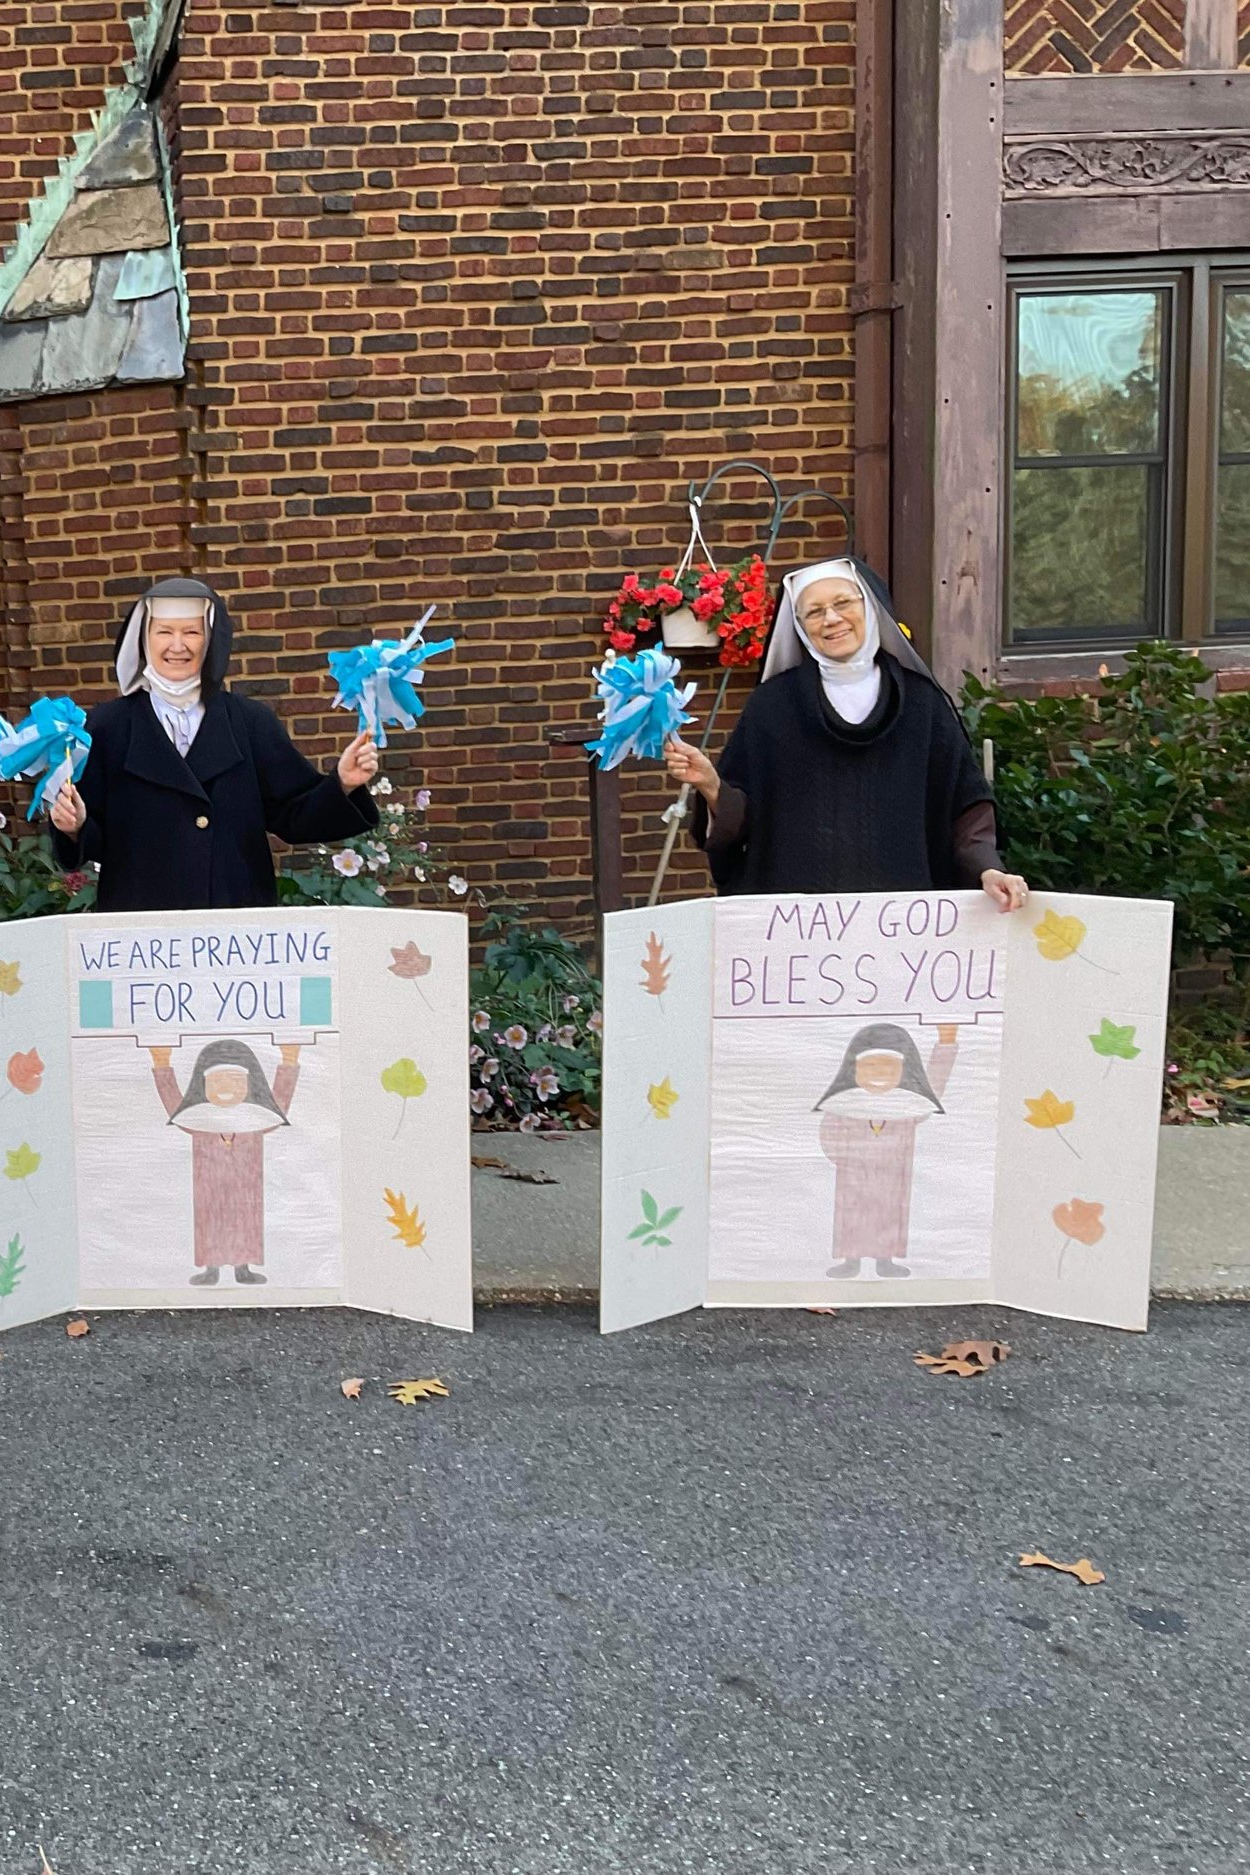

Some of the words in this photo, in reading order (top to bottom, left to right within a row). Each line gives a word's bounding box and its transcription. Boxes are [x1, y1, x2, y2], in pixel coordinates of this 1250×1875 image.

[766, 900, 860, 940] MAY
[878, 899, 958, 937] GOD
[80, 941, 121, 970] WE
[129, 938, 181, 969] ARE
[192, 931, 331, 968] PRAYING
[731, 953, 878, 1006] BLESS
[900, 949, 997, 1003] YOU
[129, 982, 196, 1024] FOR
[213, 981, 286, 1021] YOU
